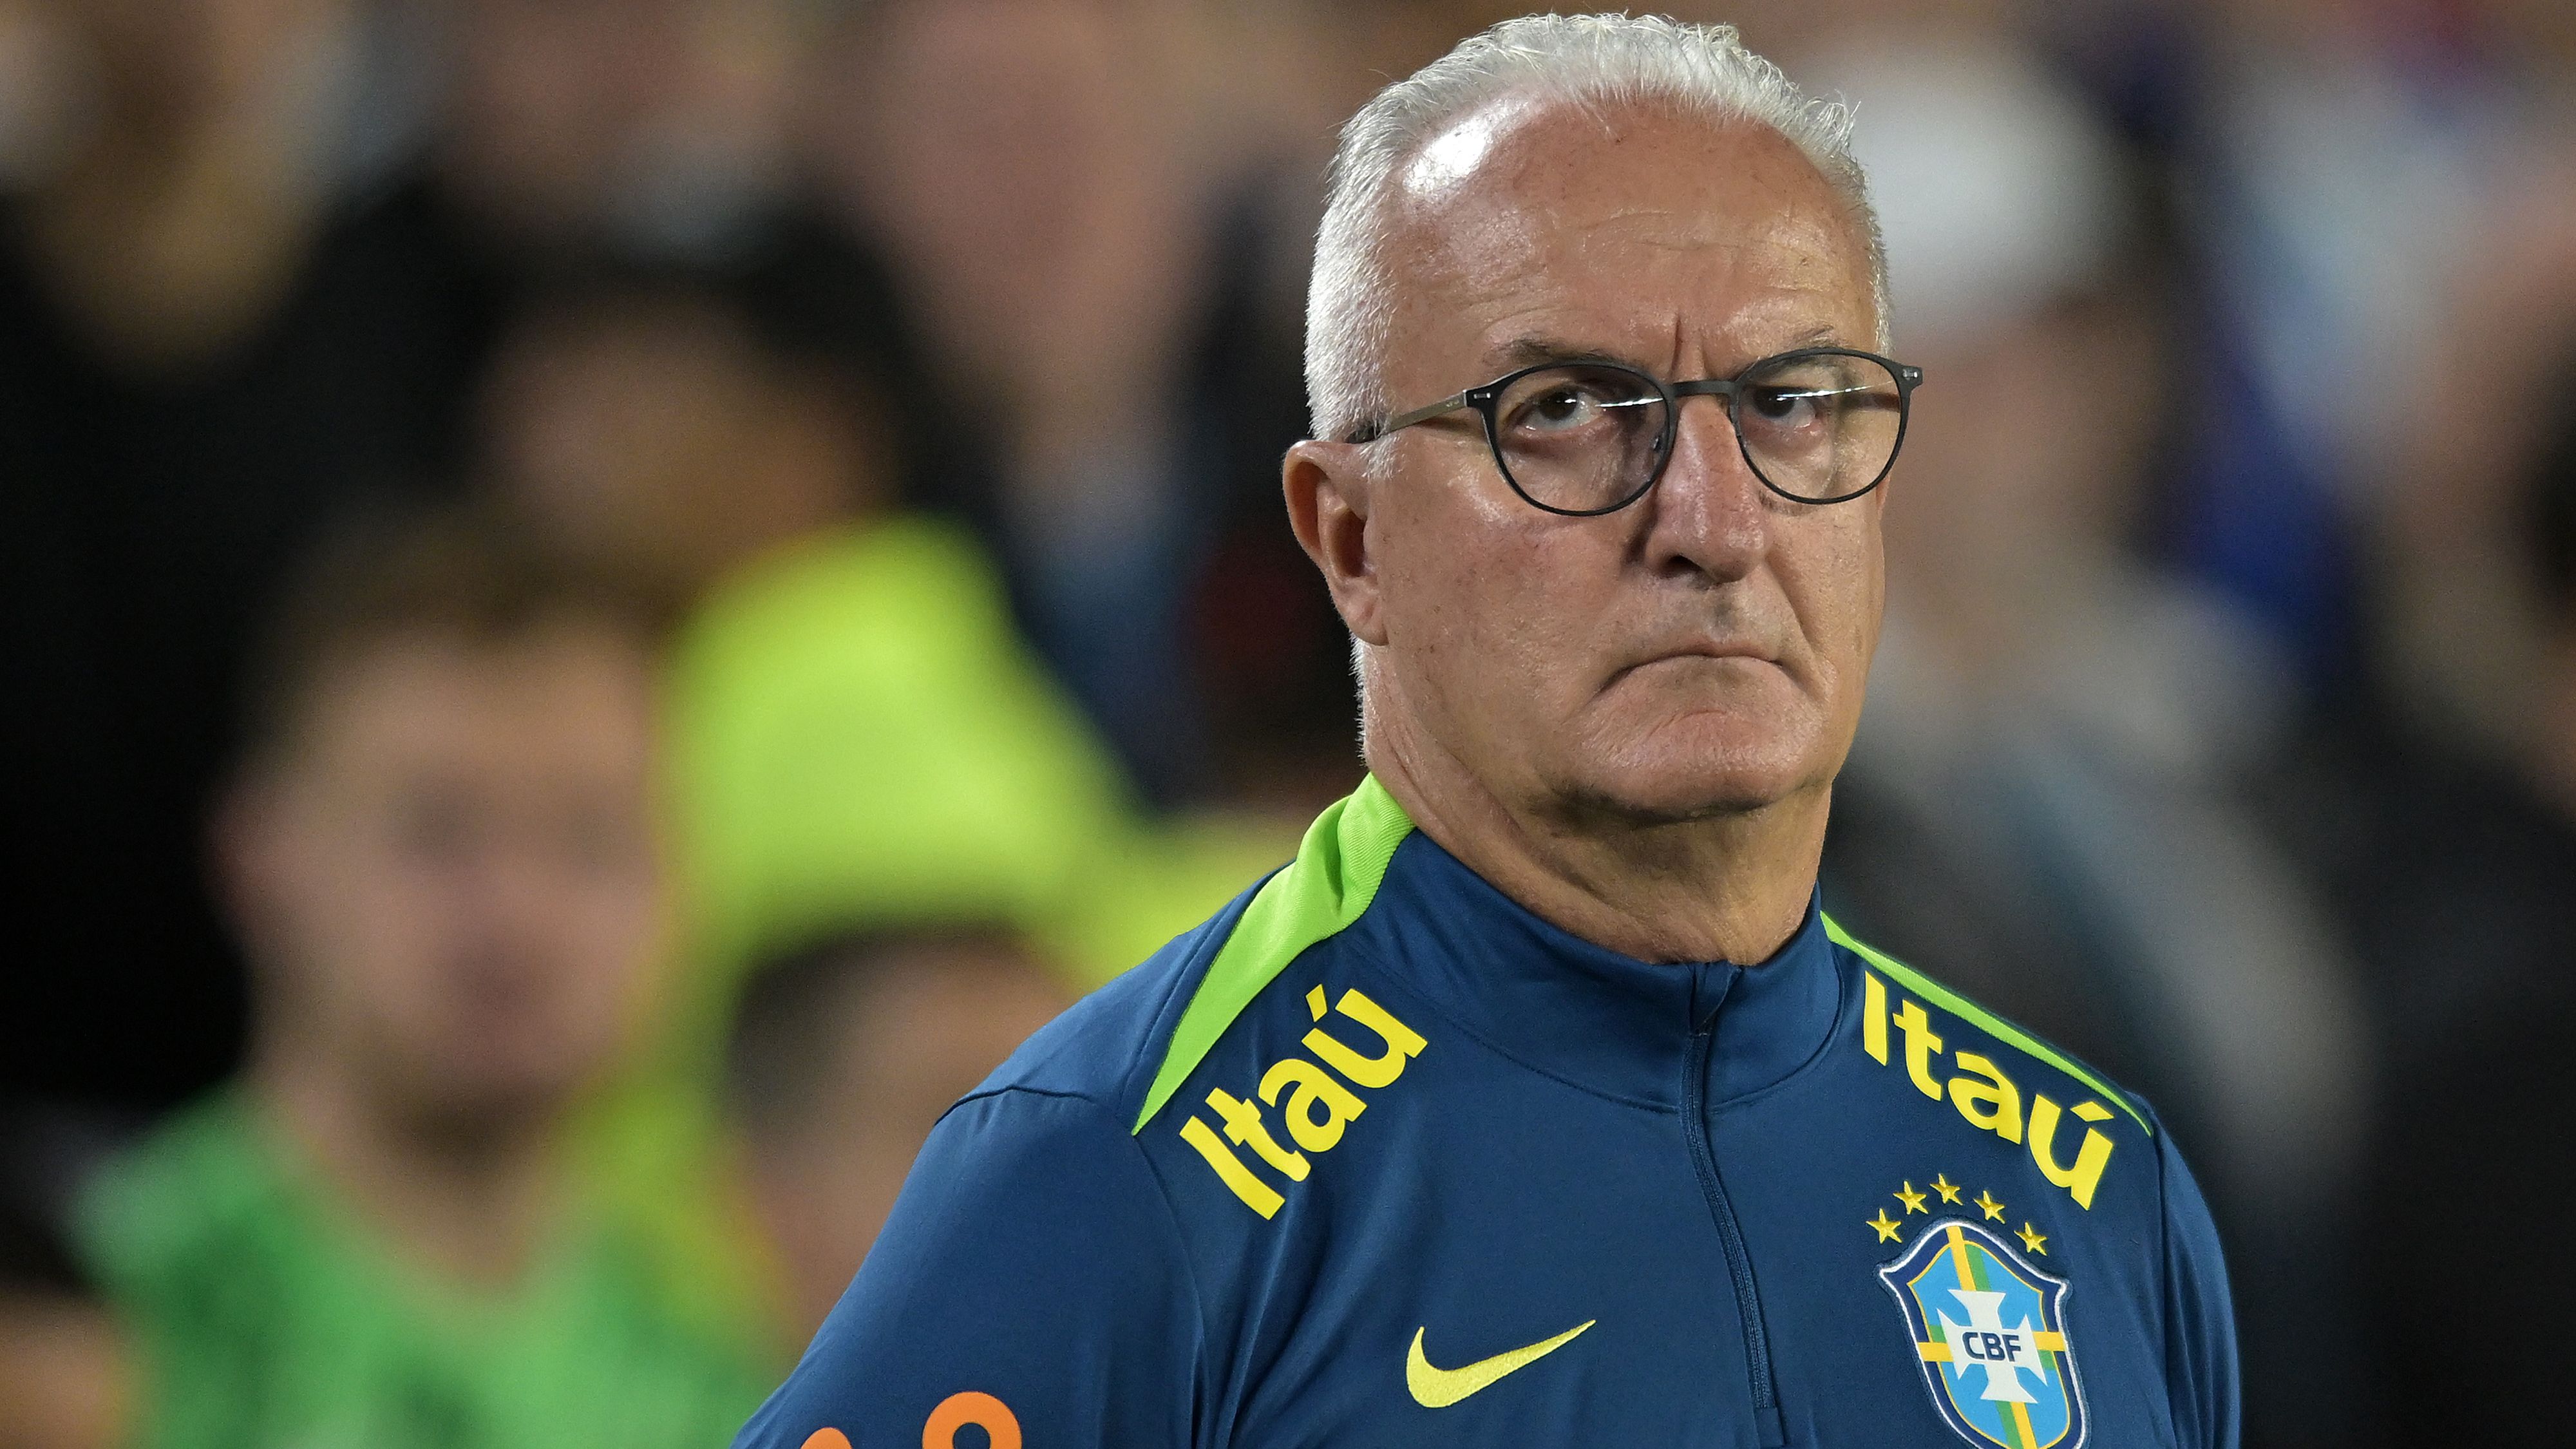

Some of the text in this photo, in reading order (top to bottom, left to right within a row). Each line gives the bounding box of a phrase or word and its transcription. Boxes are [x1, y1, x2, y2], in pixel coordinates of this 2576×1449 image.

[1179, 983, 1428, 1220] Itaú
[1863, 971, 2114, 1211] Itaú
[1962, 1331, 2022, 1362] CBF
